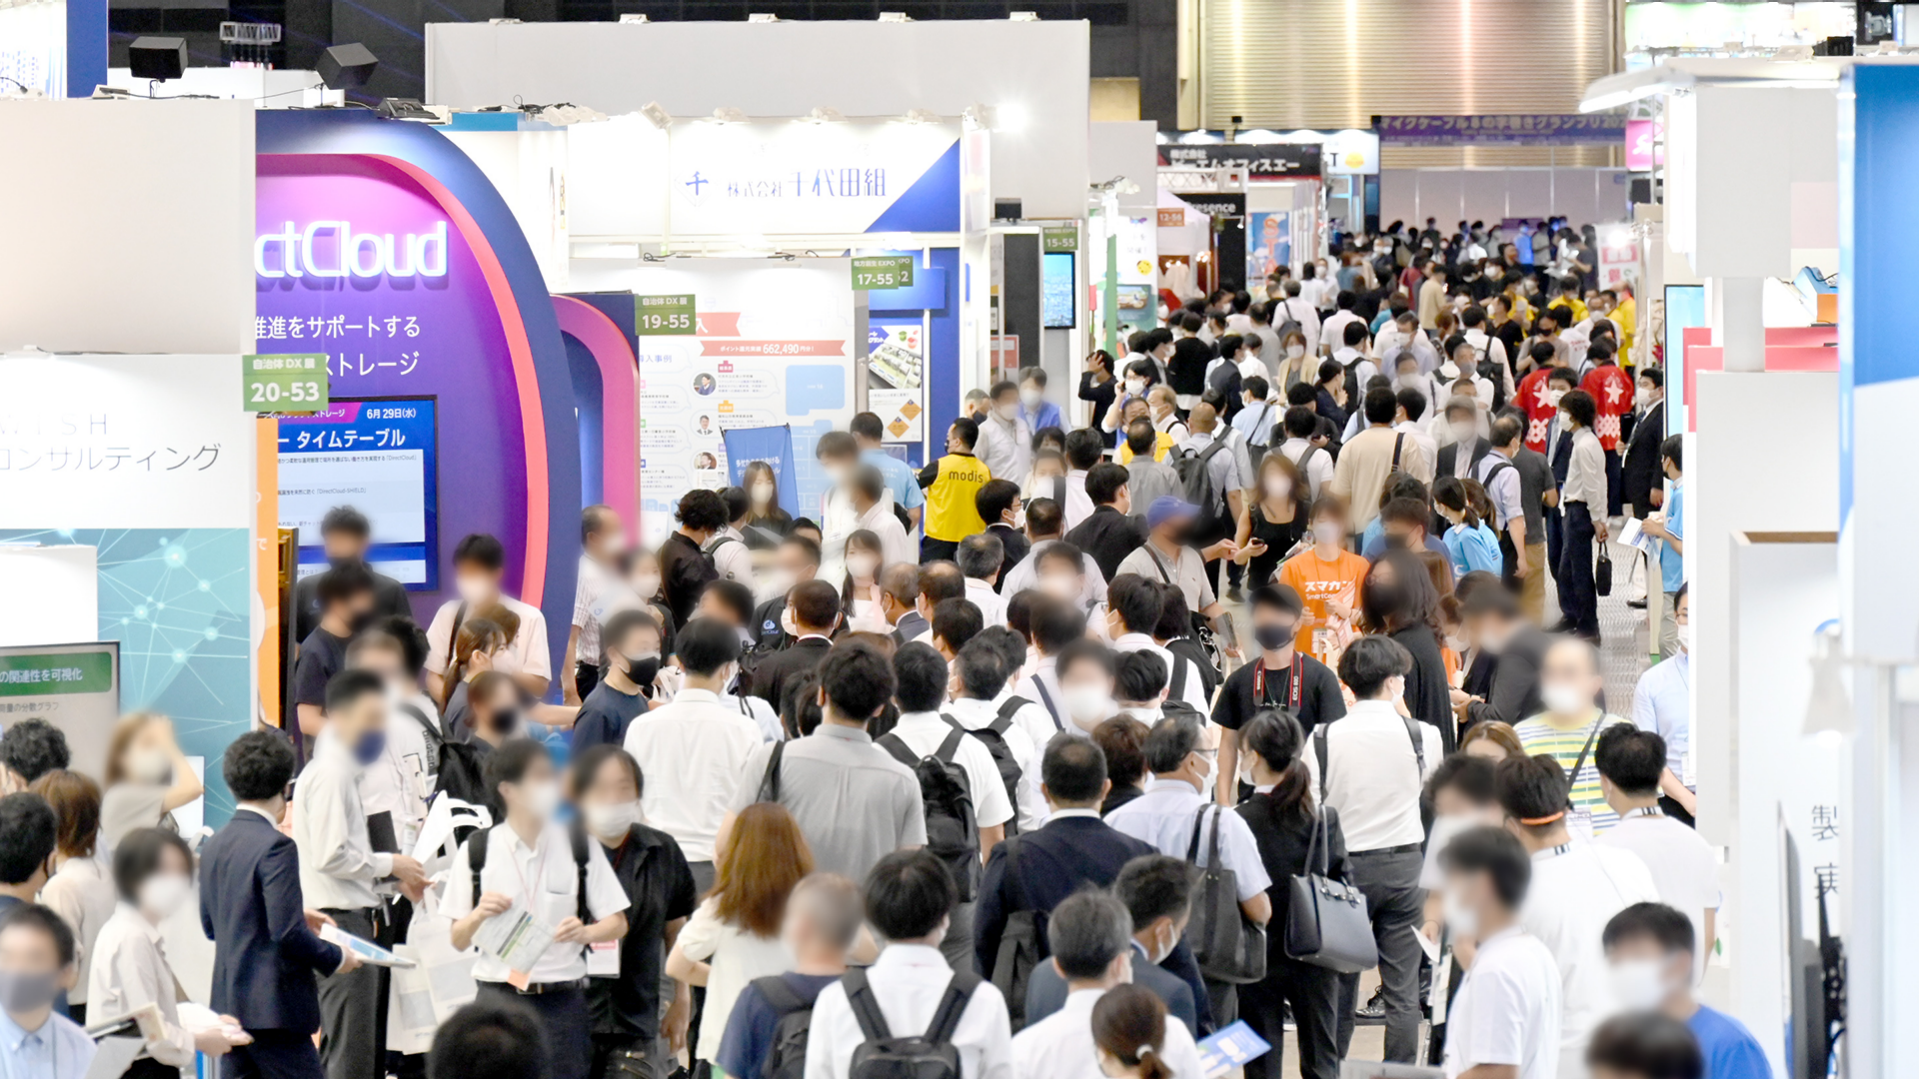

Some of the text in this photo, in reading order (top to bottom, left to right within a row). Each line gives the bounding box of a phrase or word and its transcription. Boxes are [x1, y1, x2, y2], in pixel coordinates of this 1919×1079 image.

[1170, 148, 1207, 159] 株式会社
[727, 167, 886, 198] 株式会社 千代田組
[1046, 238, 1075, 248] 15-55
[857, 273, 894, 286] 17-55
[642, 297, 665, 306] 自治体
[666, 297, 679, 306] DX
[641, 314, 690, 329] 19-55
[762, 343, 800, 355] 662,490
[252, 357, 316, 370] 自治体 DX 展
[250, 381, 320, 403] 20-53
[366, 408, 381, 420] 6月
[296, 428, 406, 450] タイムテーブル
[0, 442, 222, 472] コンサルティング
[948, 469, 984, 484] modis
[0, 667, 83, 684] の関連性を可視化
